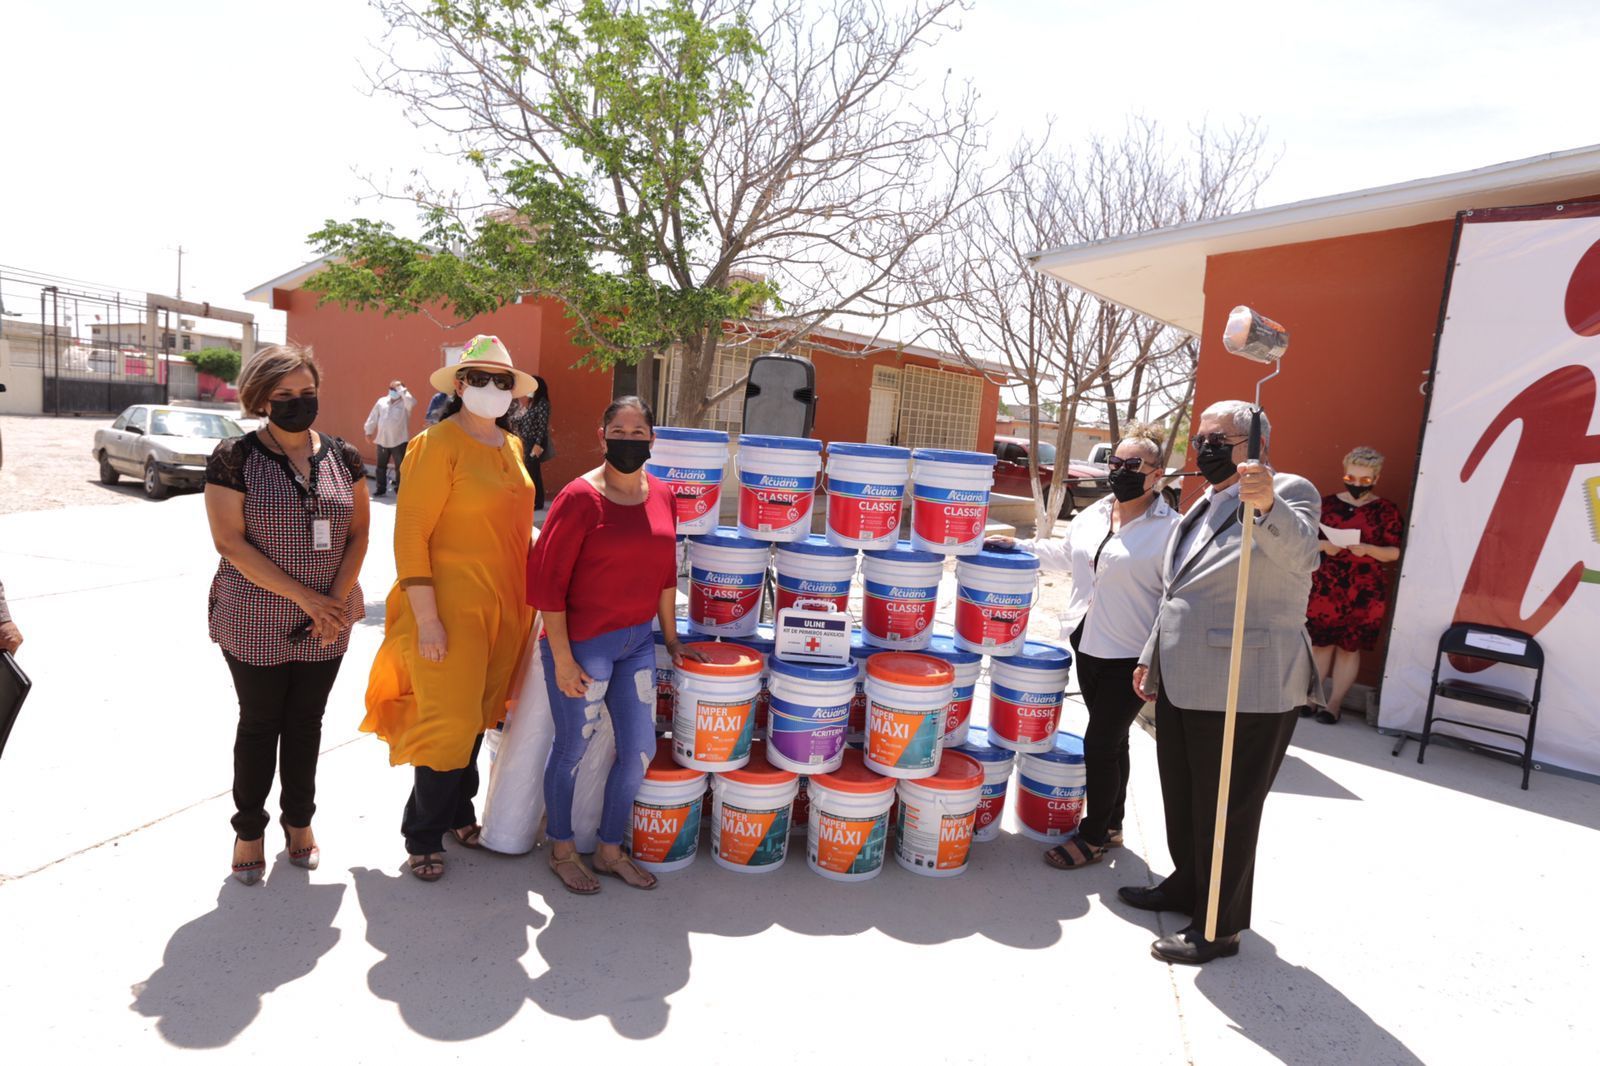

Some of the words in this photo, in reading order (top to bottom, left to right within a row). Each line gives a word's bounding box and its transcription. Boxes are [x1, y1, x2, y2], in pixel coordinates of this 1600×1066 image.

[666, 468, 706, 480] Acuario
[760, 475, 799, 488] Acuario
[861, 484, 898, 496] Acuario
[946, 490, 984, 502] Acuario
[757, 491, 798, 504] CLASSIC
[858, 501, 897, 513] CLASSIC
[943, 506, 983, 518] CLASSIC
[705, 572, 744, 585] Acuario
[798, 580, 837, 593] Acuario
[702, 587, 744, 600] CLASSIC
[888, 587, 927, 599] Acuario
[984, 593, 1023, 605] Acuario
[886, 602, 926, 614] CLASSIC
[981, 608, 1021, 620] CLASSIC
[804, 620, 826, 629] ULINE
[1020, 692, 1057, 704] Acuario
[697, 705, 728, 716] IMPER
[872, 707, 895, 721] IMPER
[1017, 707, 1055, 719] CLASSIC
[697, 715, 742, 732] MAXI
[870, 715, 910, 739] MAXI
[1047, 801, 1083, 811] CLASSIC
[634, 807, 662, 819] IMPER
[722, 809, 749, 822] IMPER
[633, 815, 678, 834] MAXI
[721, 818, 763, 838] MAXI
[820, 817, 847, 830] IMPER
[819, 825, 862, 846] MAXI
